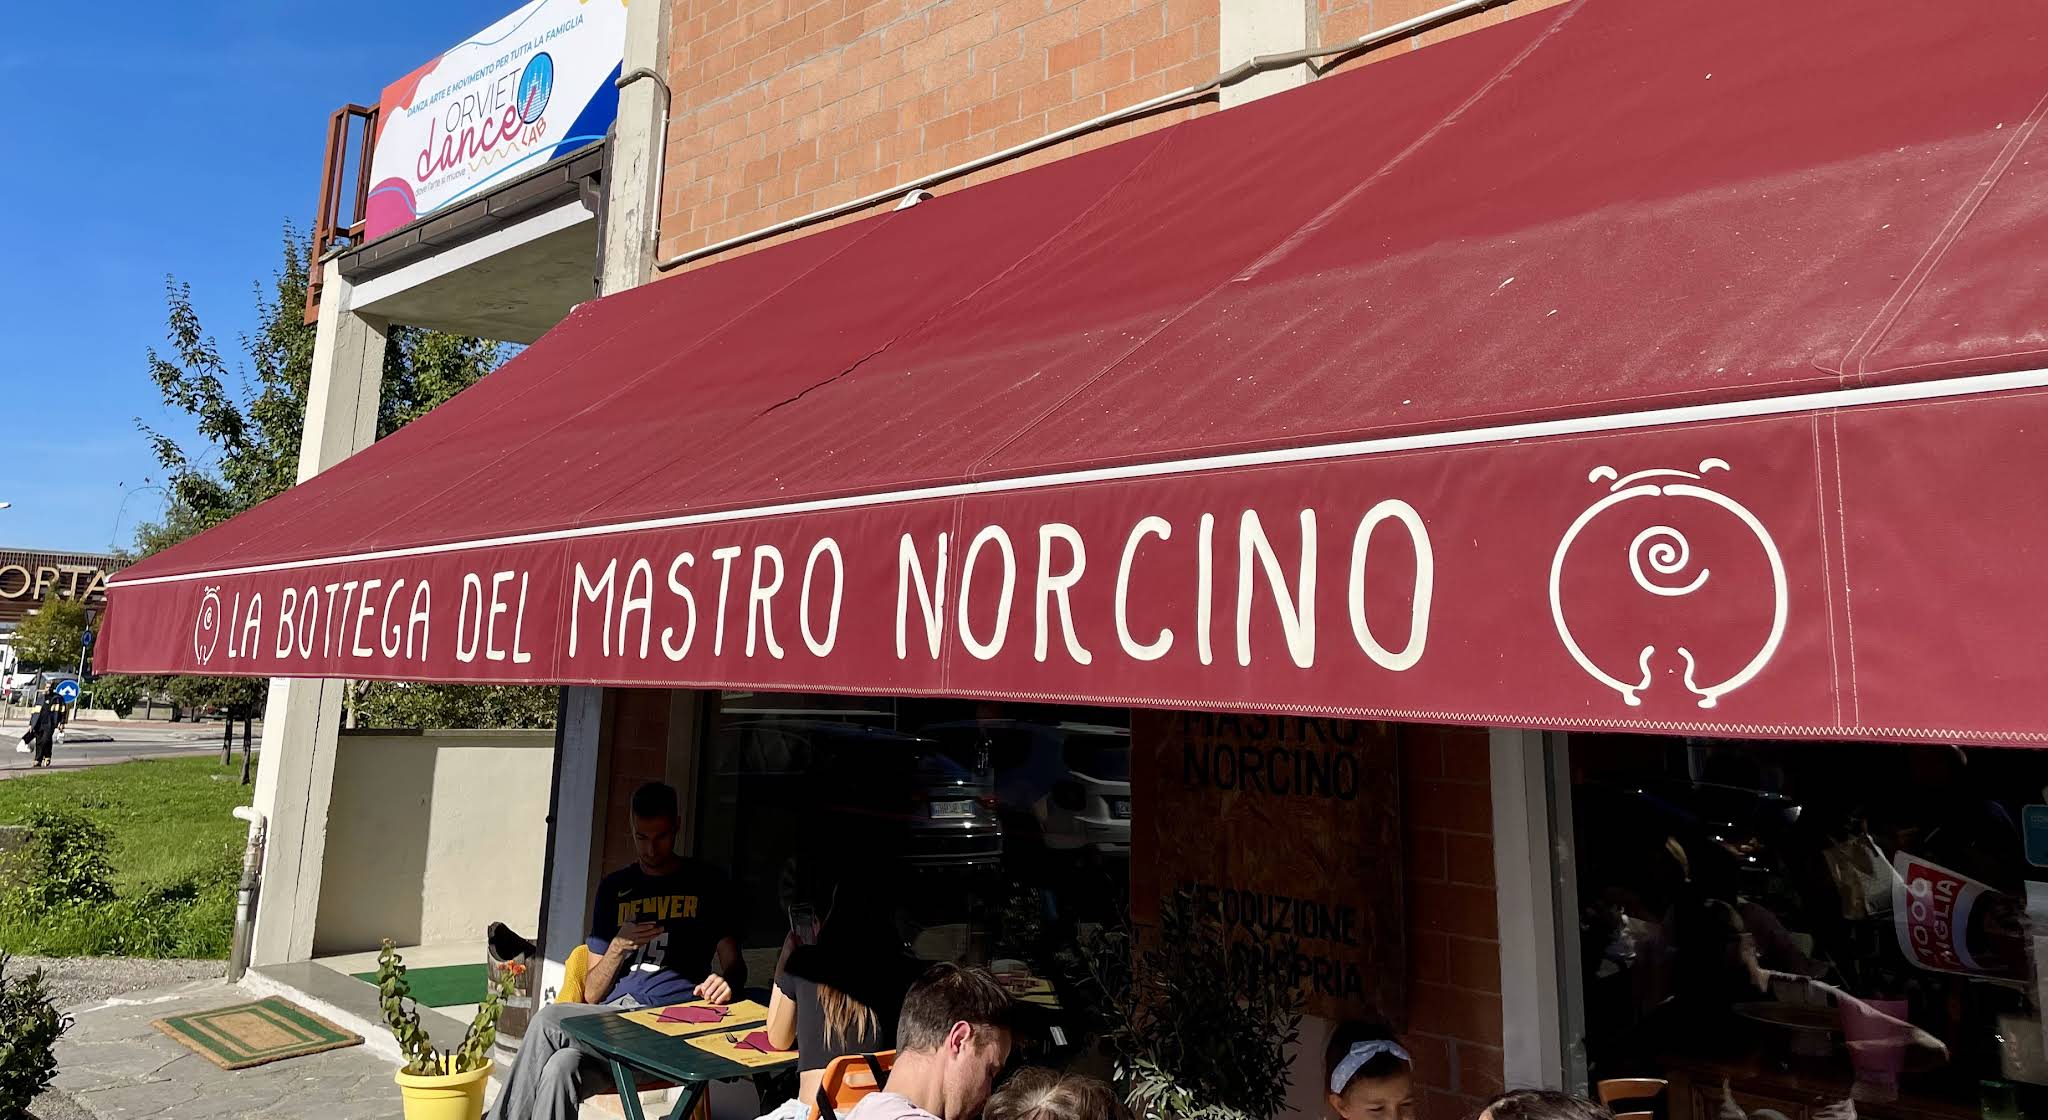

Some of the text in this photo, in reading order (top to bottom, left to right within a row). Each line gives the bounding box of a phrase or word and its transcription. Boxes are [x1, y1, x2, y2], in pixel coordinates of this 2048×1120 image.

[407, 14, 584, 118] DANZA ARTE E MOVIMENTO PER TUTTA LA FAMIGLIA
[417, 88, 536, 182] dance
[521, 117, 547, 147] LAB
[228, 499, 1434, 671] LA BOTTEGA DEL MASTRO NORCINO
[1184, 743, 1359, 801] NORCINO
[617, 895, 699, 928] DENVER
[1911, 877, 1933, 956] 1000
[1932, 879, 1960, 968] MIGLIA
